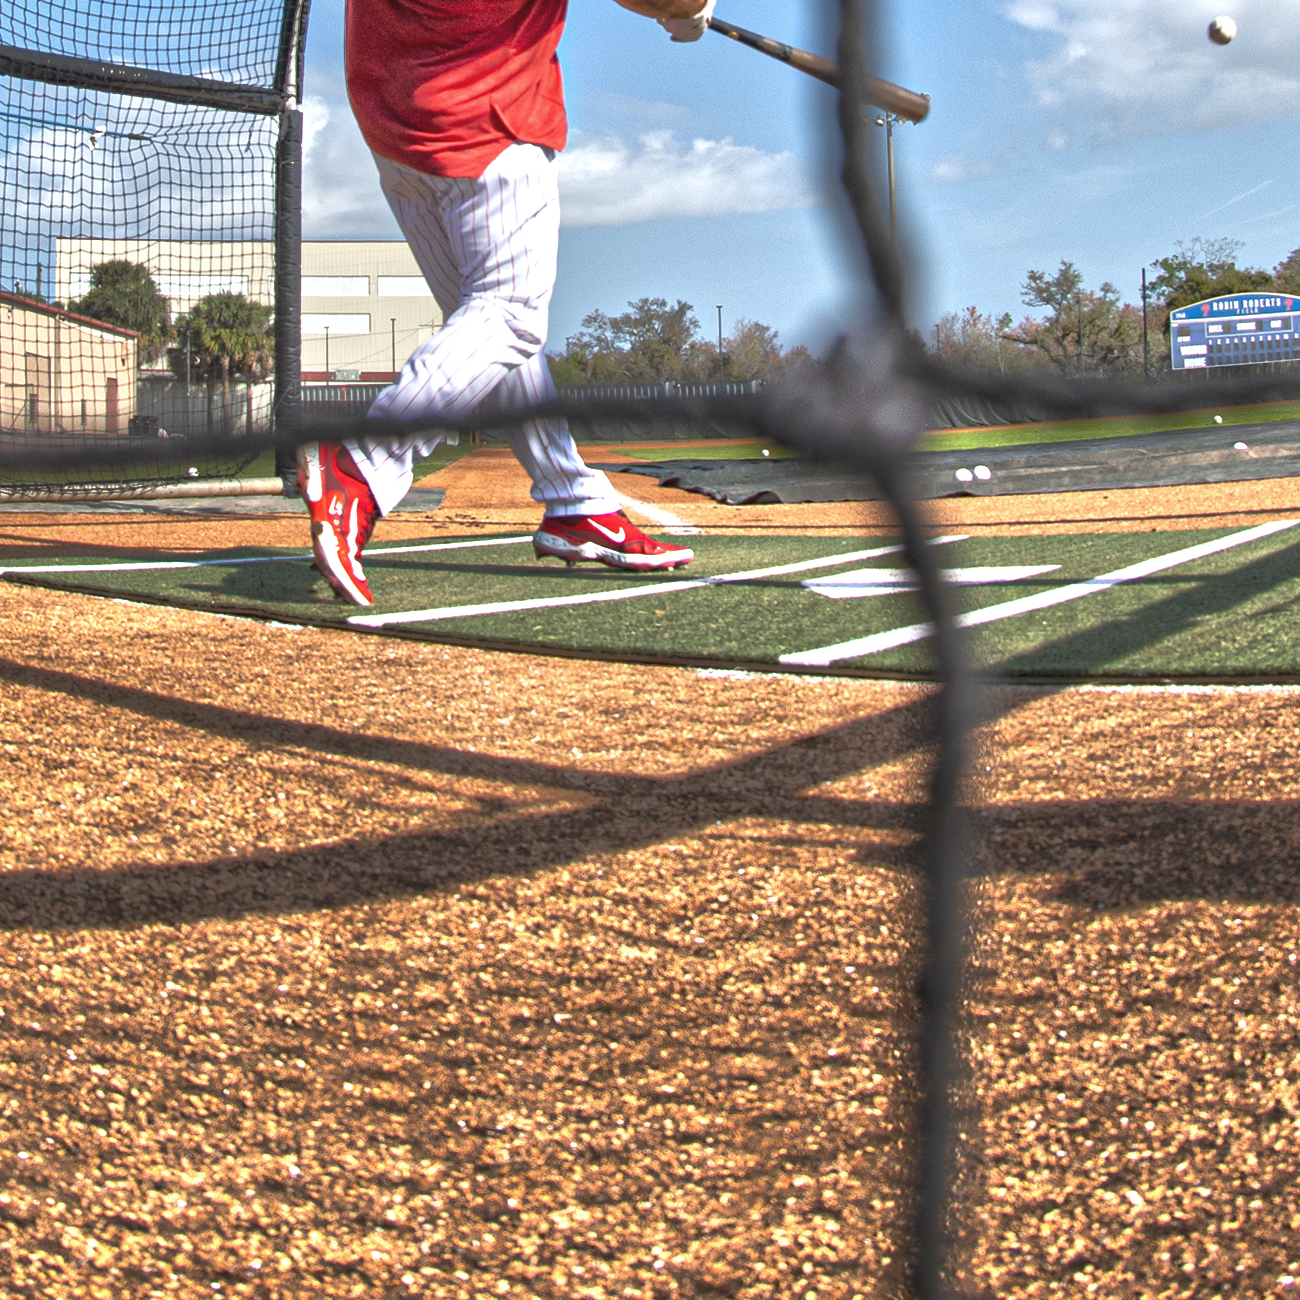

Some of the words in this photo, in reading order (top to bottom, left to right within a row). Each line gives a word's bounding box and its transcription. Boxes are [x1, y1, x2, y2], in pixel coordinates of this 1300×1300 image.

[1213, 301, 1239, 311] ROBIN
[1243, 298, 1281, 308] ROBERTS
[1184, 357, 1206, 369] HOME
